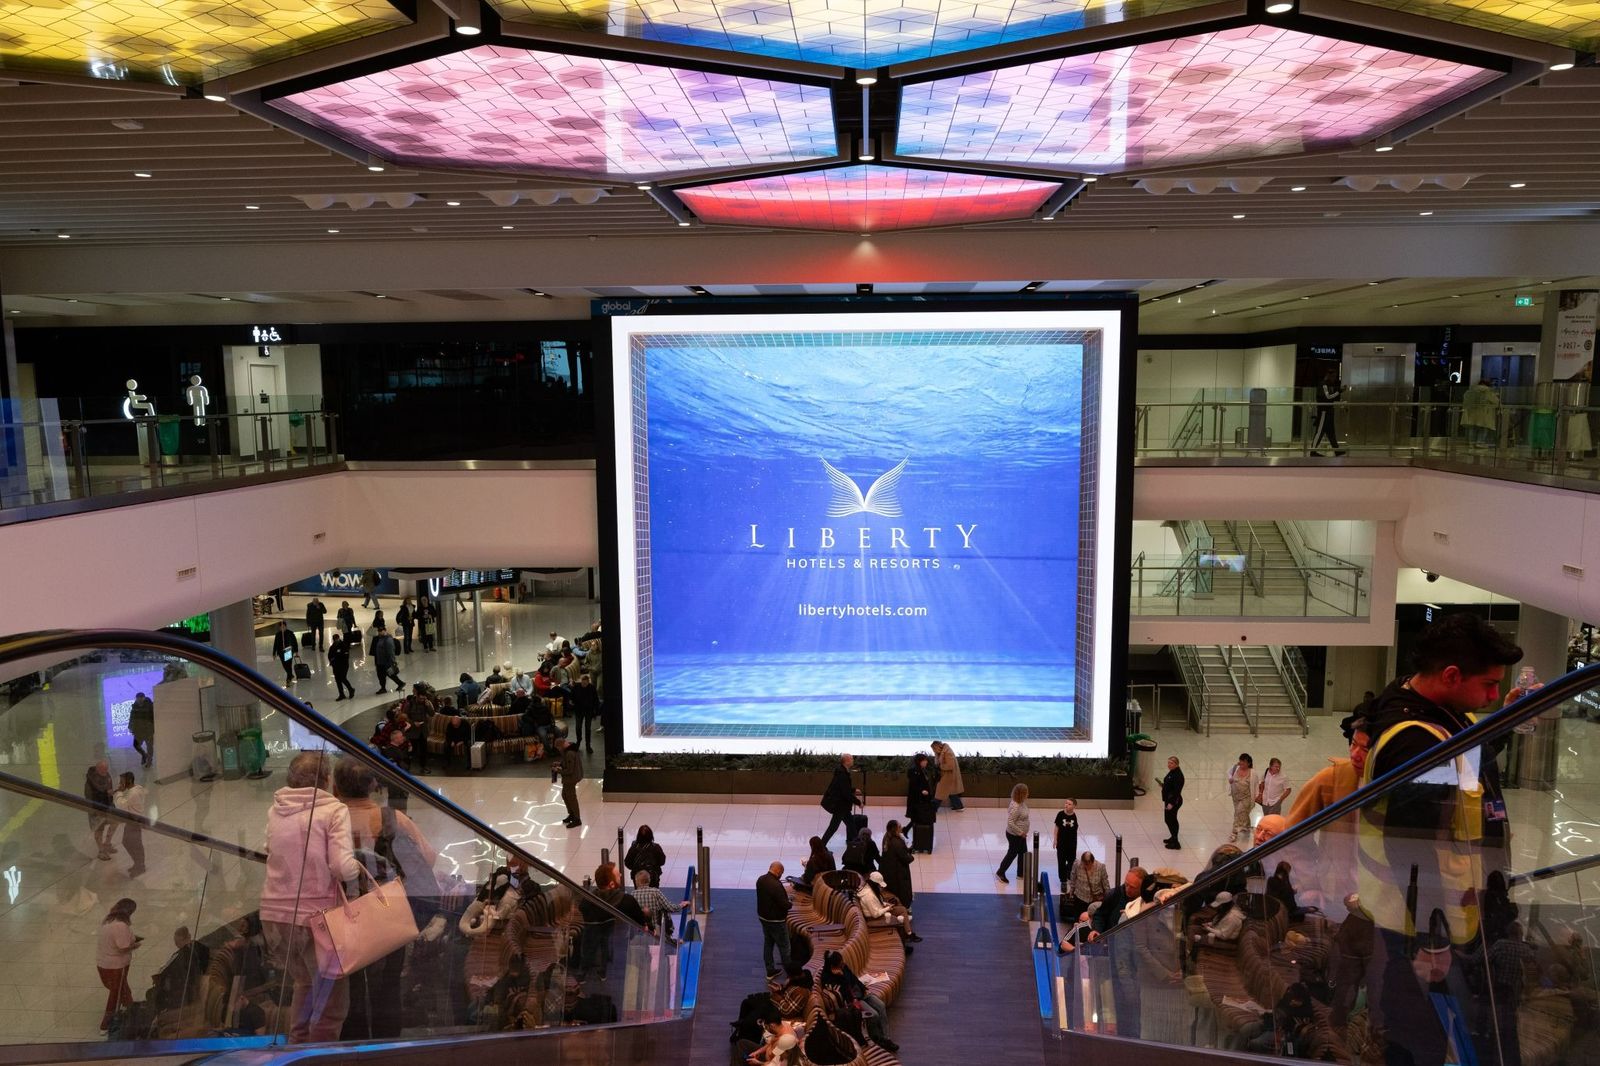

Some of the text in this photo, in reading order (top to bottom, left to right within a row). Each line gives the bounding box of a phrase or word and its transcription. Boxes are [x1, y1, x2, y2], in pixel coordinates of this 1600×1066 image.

[601, 301, 631, 314] global
[749, 524, 977, 549] LIBERTY
[787, 558, 941, 569] HOTELS & RESORTS
[798, 604, 928, 619] libertyhotels.com
